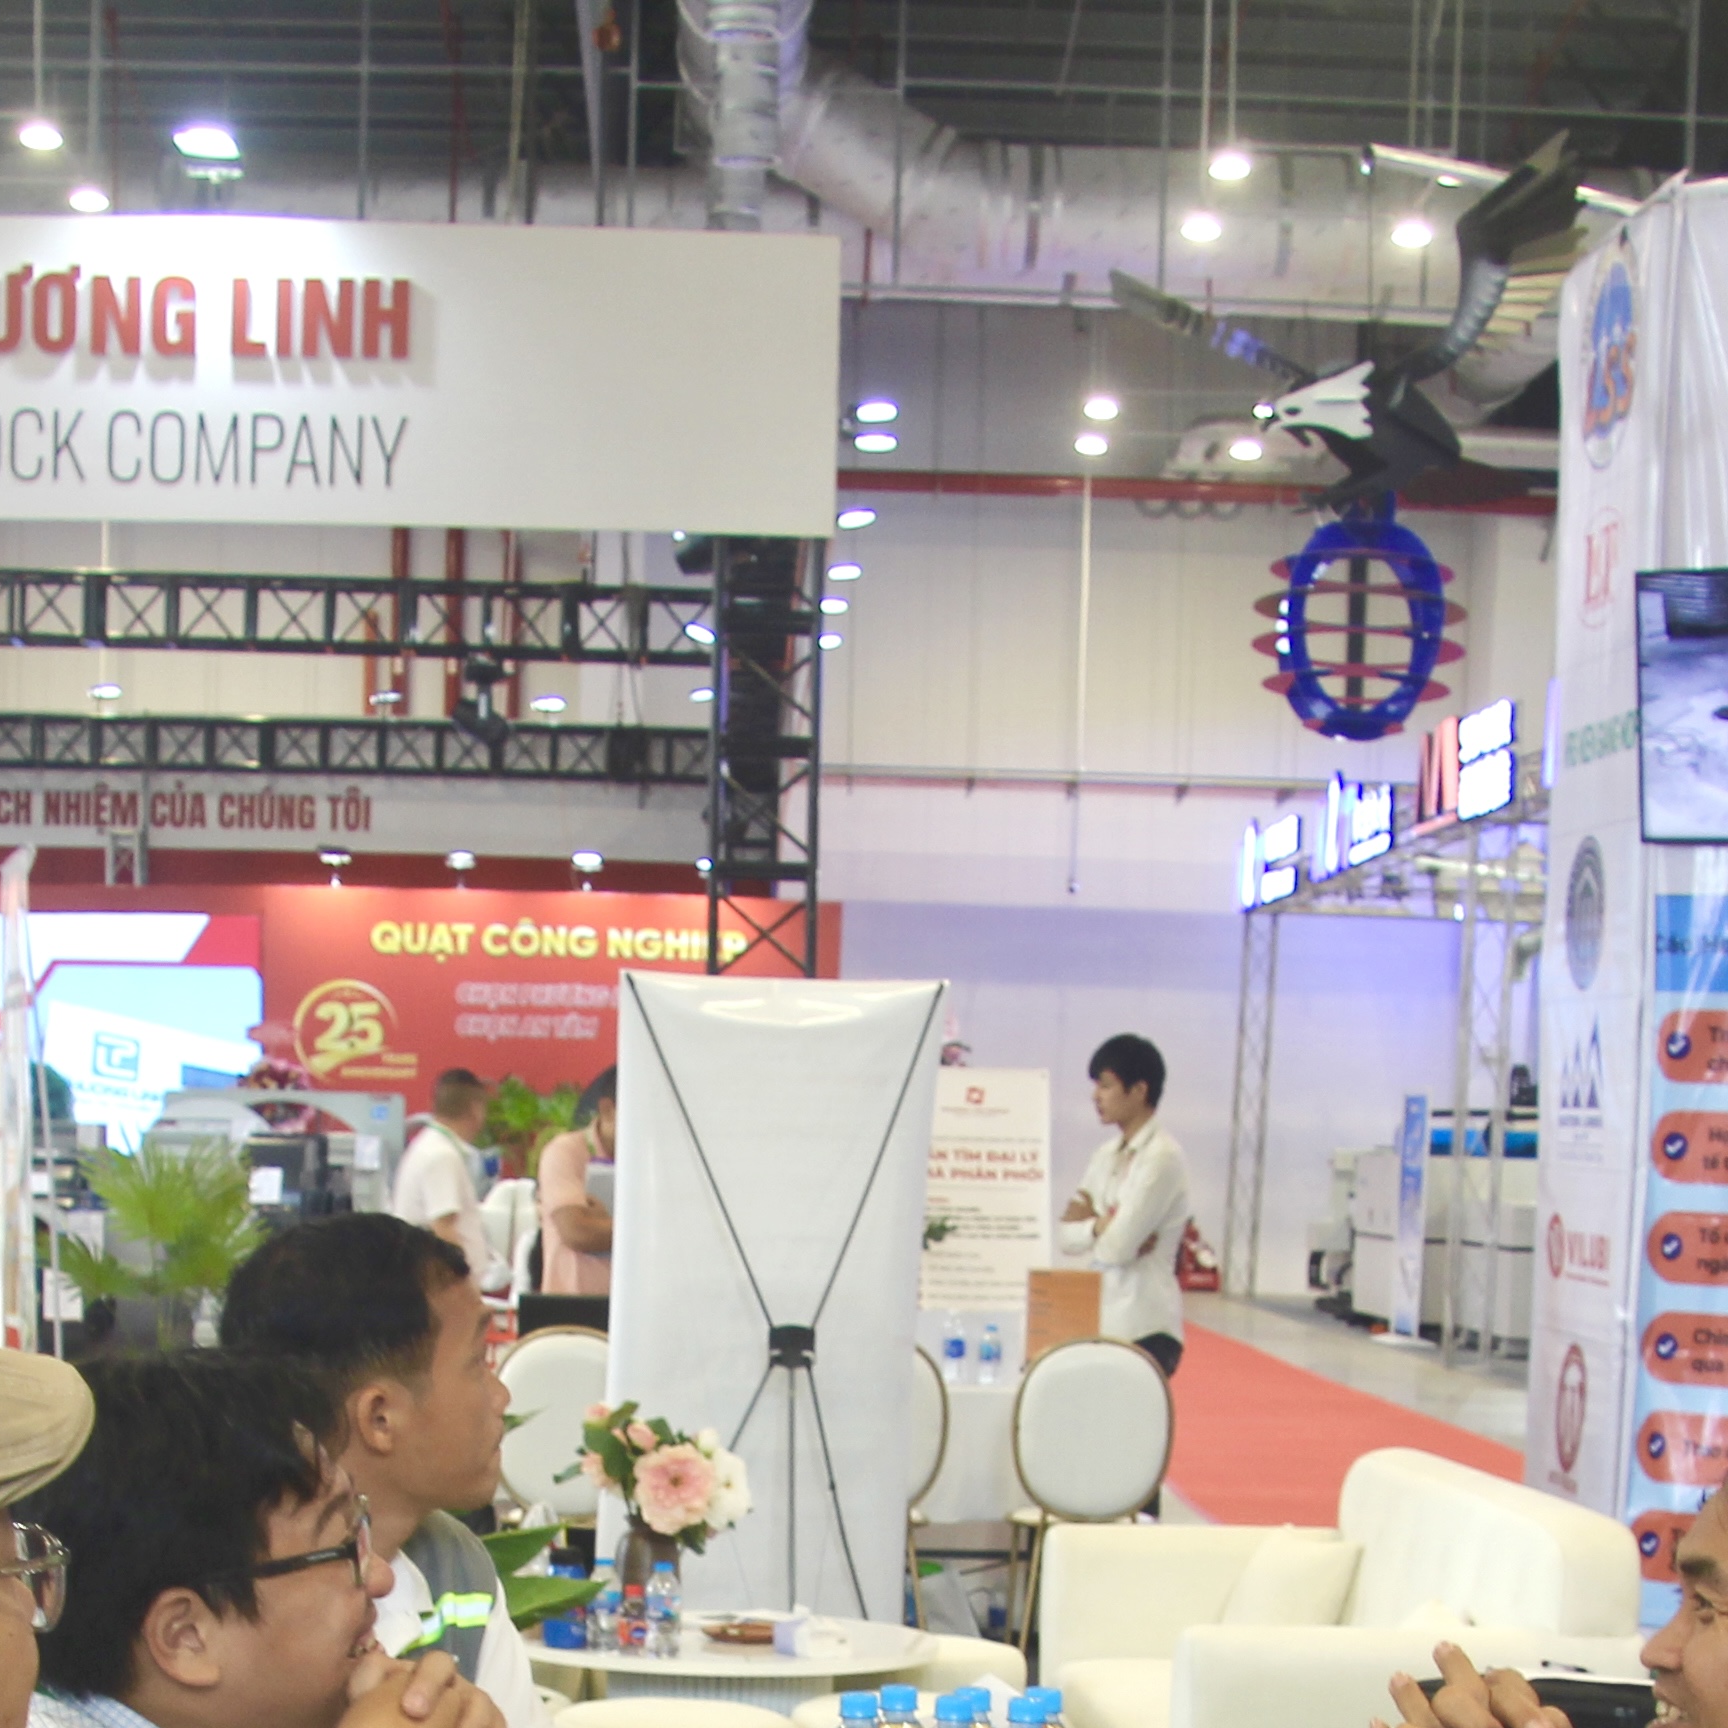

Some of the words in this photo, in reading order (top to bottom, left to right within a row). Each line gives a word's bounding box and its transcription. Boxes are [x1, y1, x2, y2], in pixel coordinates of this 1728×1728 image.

[231, 278, 411, 359] LINH
[108, 409, 409, 488] COMPANY
[150, 786, 207, 829] CỦA
[218, 787, 316, 831] CHÚNG
[327, 787, 371, 833] TÔI
[370, 921, 473, 963] QUẠT
[481, 917, 597, 959] CÔNG
[607, 927, 747, 962] NGHIP
[314, 1001, 385, 1052] 25
